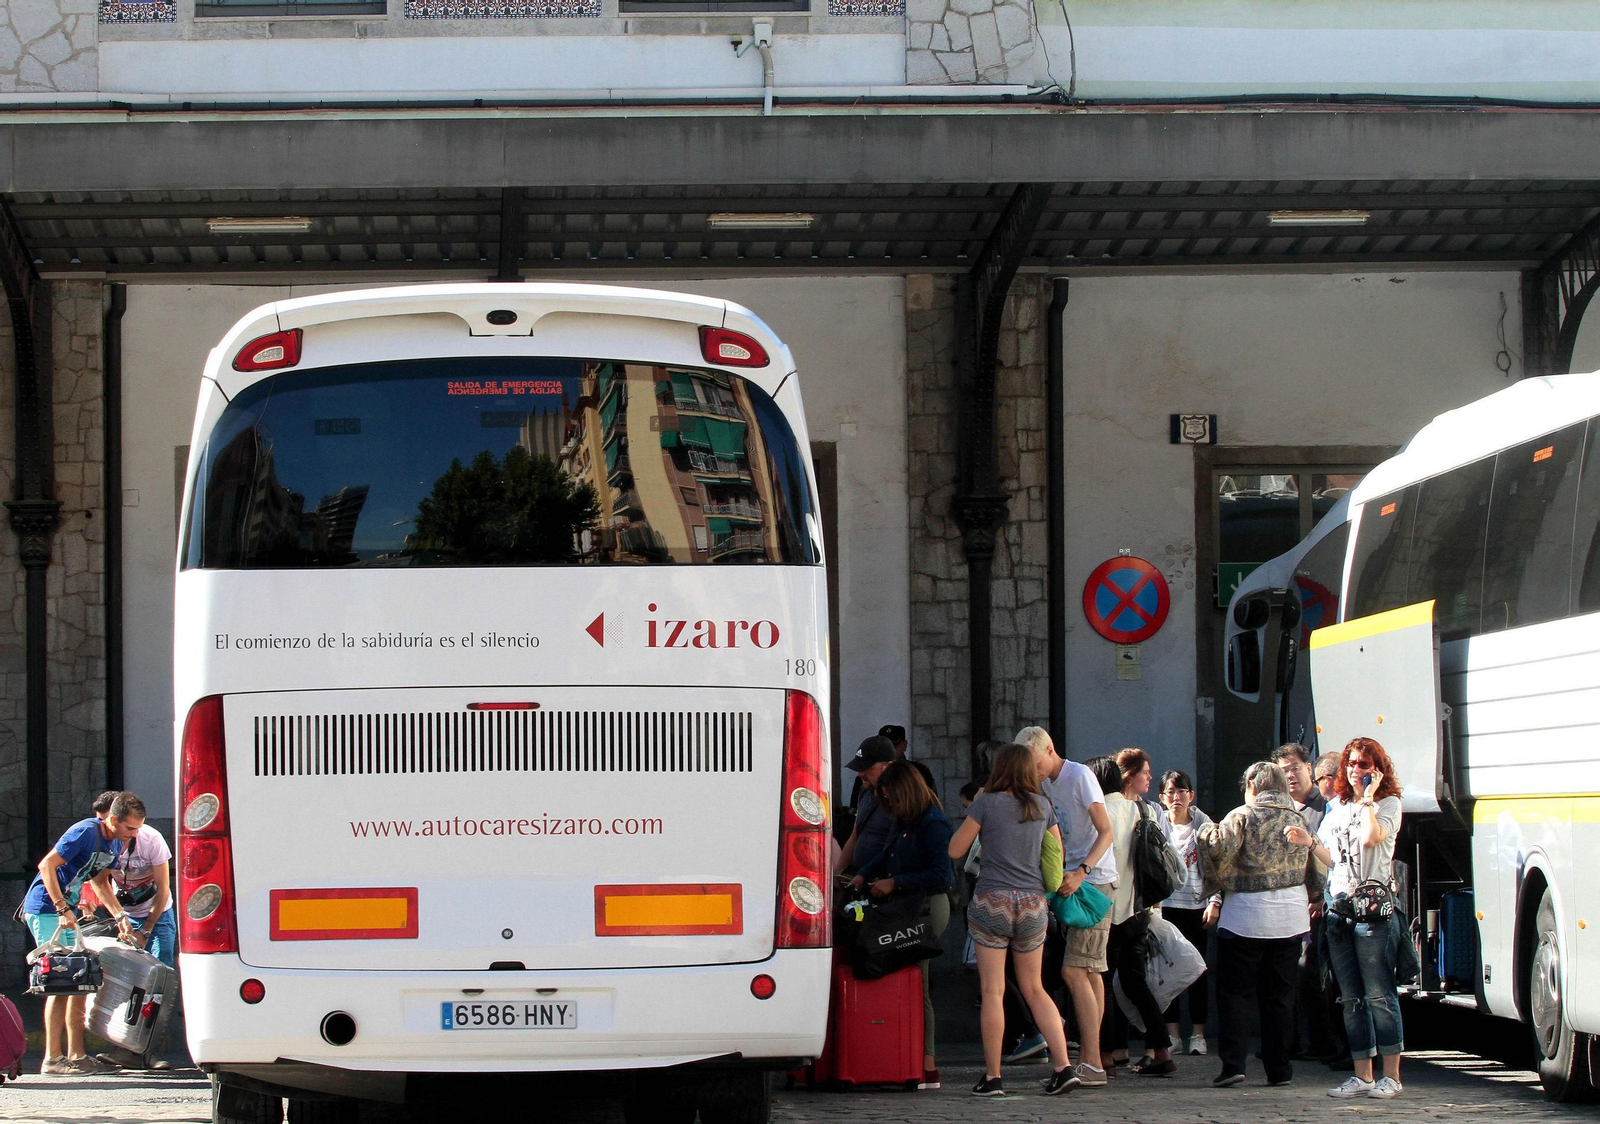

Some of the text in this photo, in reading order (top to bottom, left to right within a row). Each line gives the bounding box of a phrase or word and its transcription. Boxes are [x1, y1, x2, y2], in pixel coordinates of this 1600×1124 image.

[644, 602, 780, 649] izaro
[215, 631, 541, 650] El comienzo de la sabiduría es el silencio
[785, 659, 816, 676] 180
[349, 812, 664, 838] www.autocaresizaro.com
[878, 923, 925, 945] GANT
[444, 1004, 568, 1026] E 6586 HNY
